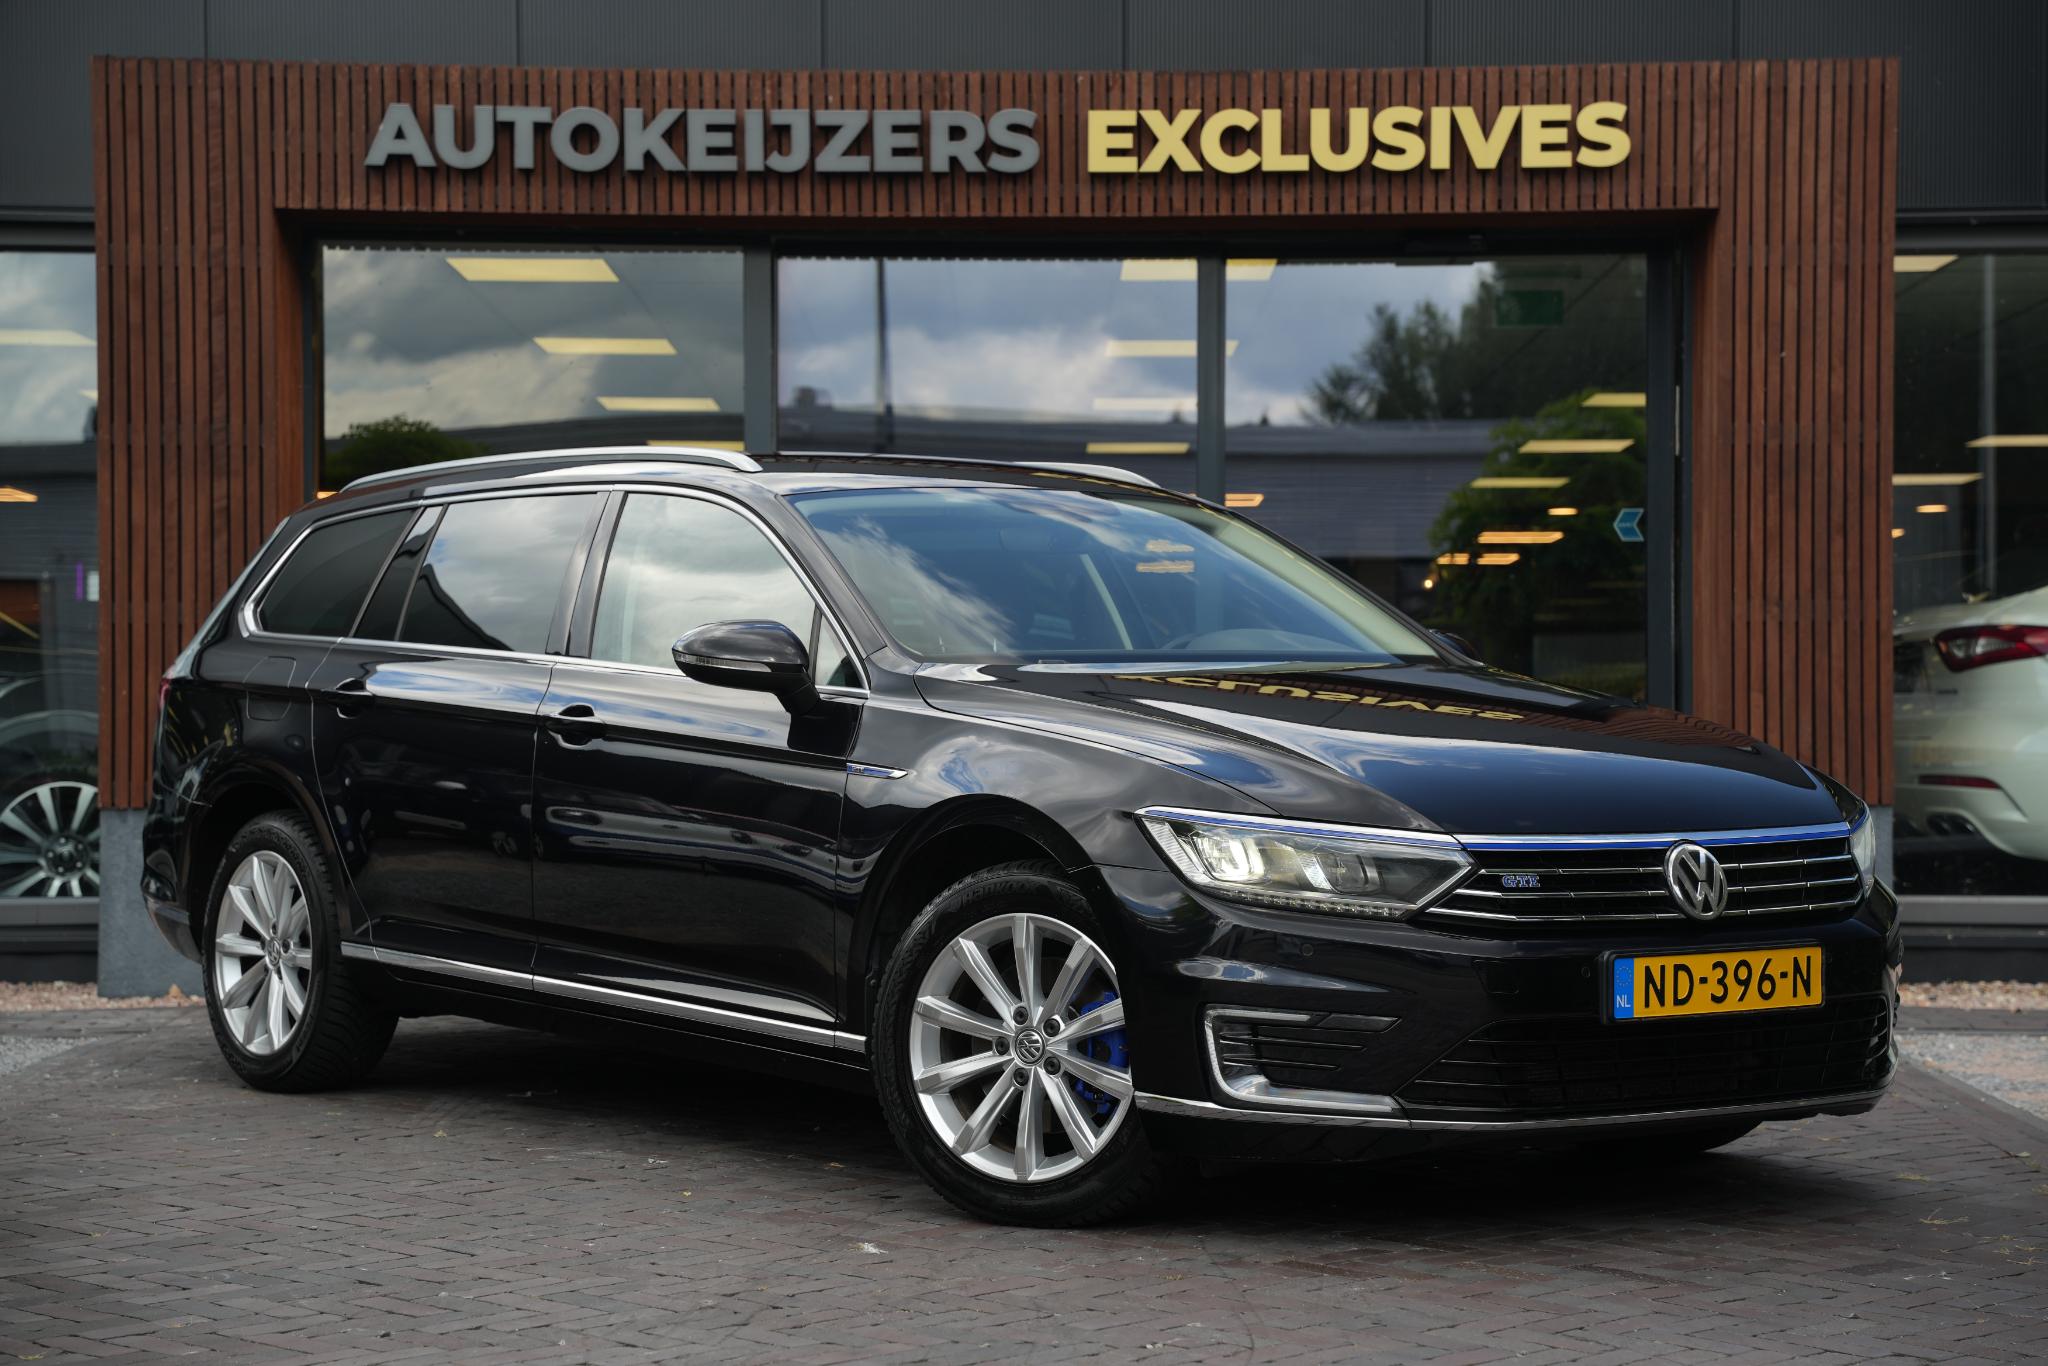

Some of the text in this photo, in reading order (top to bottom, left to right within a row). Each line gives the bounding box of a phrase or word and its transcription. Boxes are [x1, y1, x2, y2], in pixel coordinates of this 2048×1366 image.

[364, 101, 1632, 174] AUTOKEIJZERS EXCLUSIVES
[1502, 874, 1541, 888] GTE
[1616, 955, 1811, 1009] NL ND-396-N
